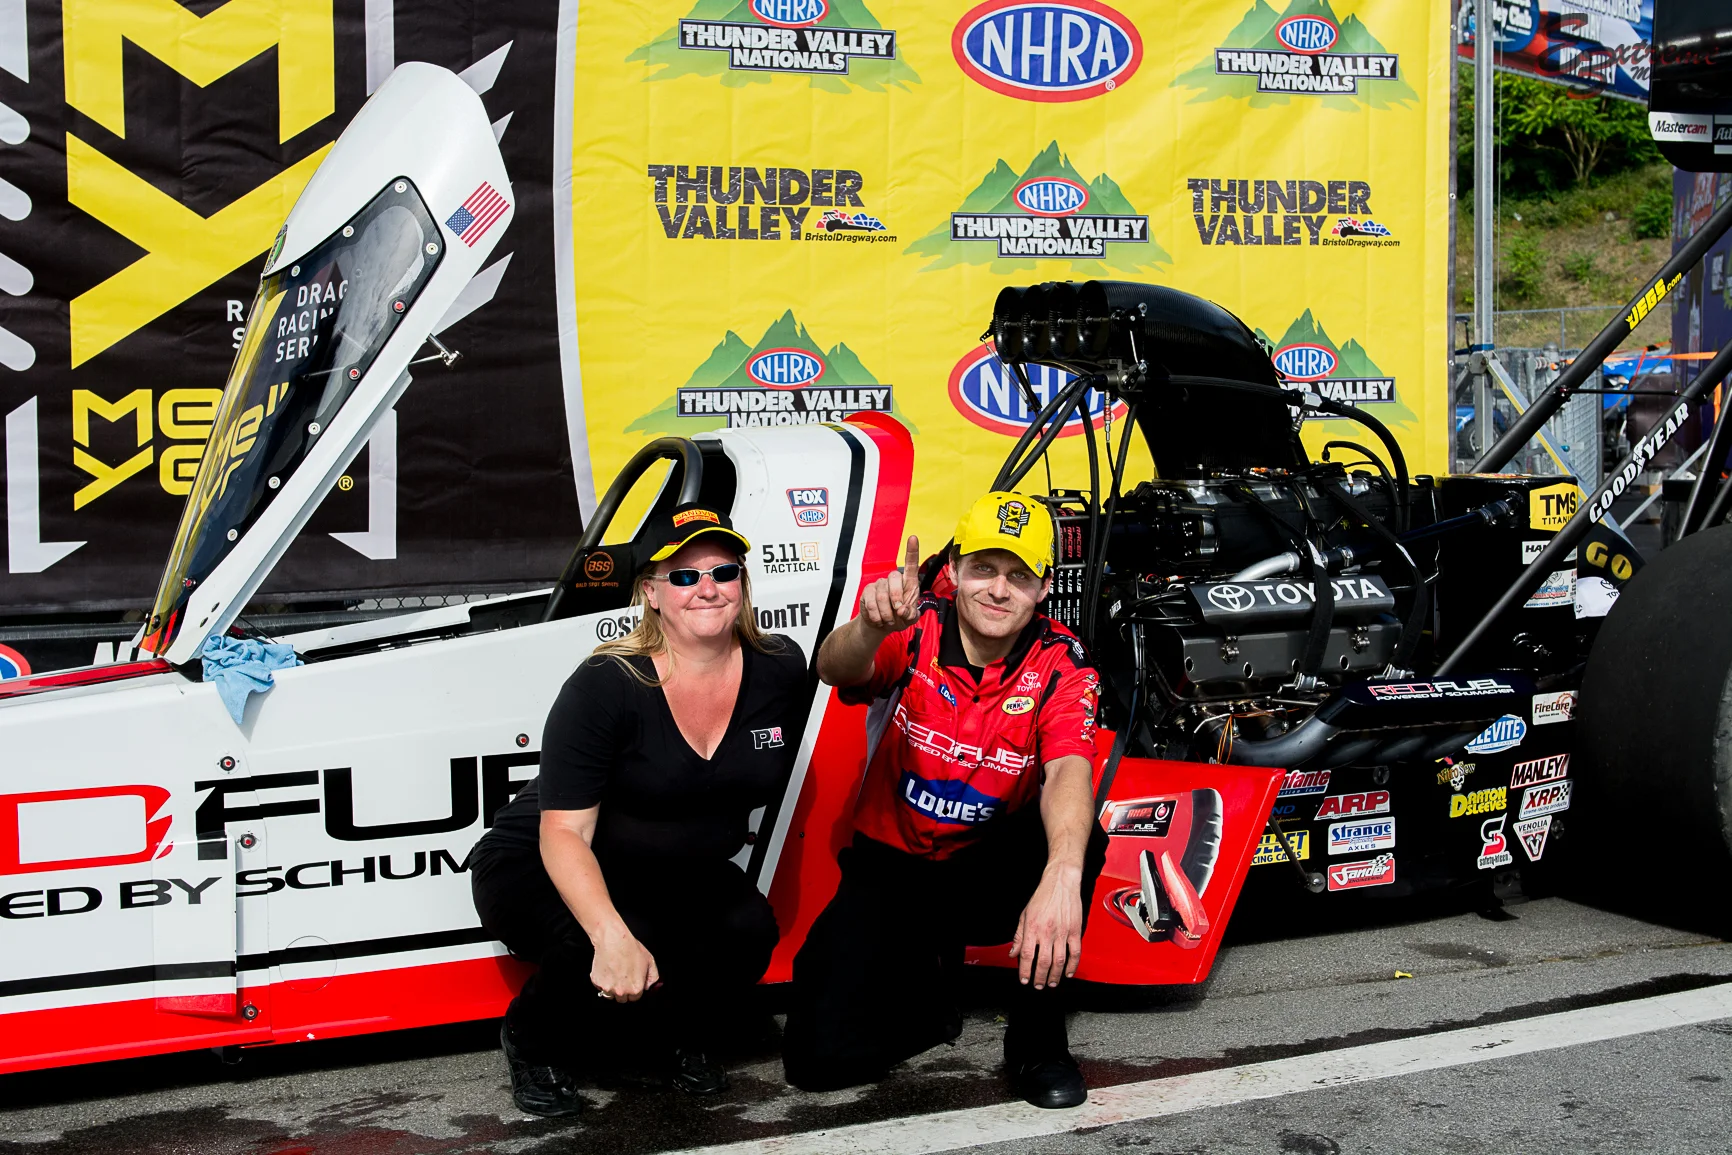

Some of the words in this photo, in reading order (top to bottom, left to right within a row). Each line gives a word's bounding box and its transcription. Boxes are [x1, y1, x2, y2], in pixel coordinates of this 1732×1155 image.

[761, 0, 819, 20] NHRA
[683, 23, 800, 50] THUNDER
[804, 30, 892, 55] VALLEY
[983, 7, 1116, 83] NHRA
[1285, 22, 1330, 48] NHRA
[733, 48, 846, 71] NATIONALS
[1218, 52, 1314, 75] THUNDER
[1317, 57, 1395, 76] VALLEY
[1261, 73, 1354, 91] NATIONALS
[1655, 120, 1707, 135] Mastercam
[648, 164, 865, 208] THUNDER
[1187, 178, 1373, 215] THUNDER
[1024, 184, 1079, 211] NHRA
[656, 204, 811, 241] VALLEY
[954, 217, 1060, 238] THUNDER
[1066, 218, 1145, 239] VALLEY
[1193, 214, 1328, 246] VALLEY
[804, 231, 898, 244] BristolDragway.com
[1001, 237, 1103, 255] NATIONALS
[1322, 238, 1401, 248] BristolDragway.com
[758, 354, 815, 384] NHRA
[1281, 349, 1330, 375] NHRA
[681, 391, 794, 413] THUNDER
[801, 389, 888, 411] VALLEY
[1318, 381, 1392, 401] VALLEY
[1589, 402, 1689, 523] GOODYEAR
[792, 489, 825, 505] FOX
[1540, 492, 1577, 516] TMS
[800, 511, 825, 522] NHRA
[762, 543, 800, 563] 5.11
[588, 561, 611, 572] BSS
[764, 561, 820, 574] TACTICAL
[1376, 693, 1430, 701] POWERED
[1445, 688, 1515, 697] SCHUMACHER
[1534, 701, 1570, 714] FireCore
[1512, 757, 1562, 787] MANLEY
[904, 778, 995, 822] LOWE'S
[1317, 791, 1389, 817] ARP
[1465, 799, 1507, 816] SLEEVES
[1525, 785, 1561, 810] XRP
[1331, 824, 1392, 842] Strange
[1518, 820, 1548, 832] VENOLIA
[1347, 843, 1376, 851] AXLES
[1479, 853, 1509, 867] safety-kleen
[120, 877, 222, 909] BY
[235, 848, 474, 898] SCHUM
